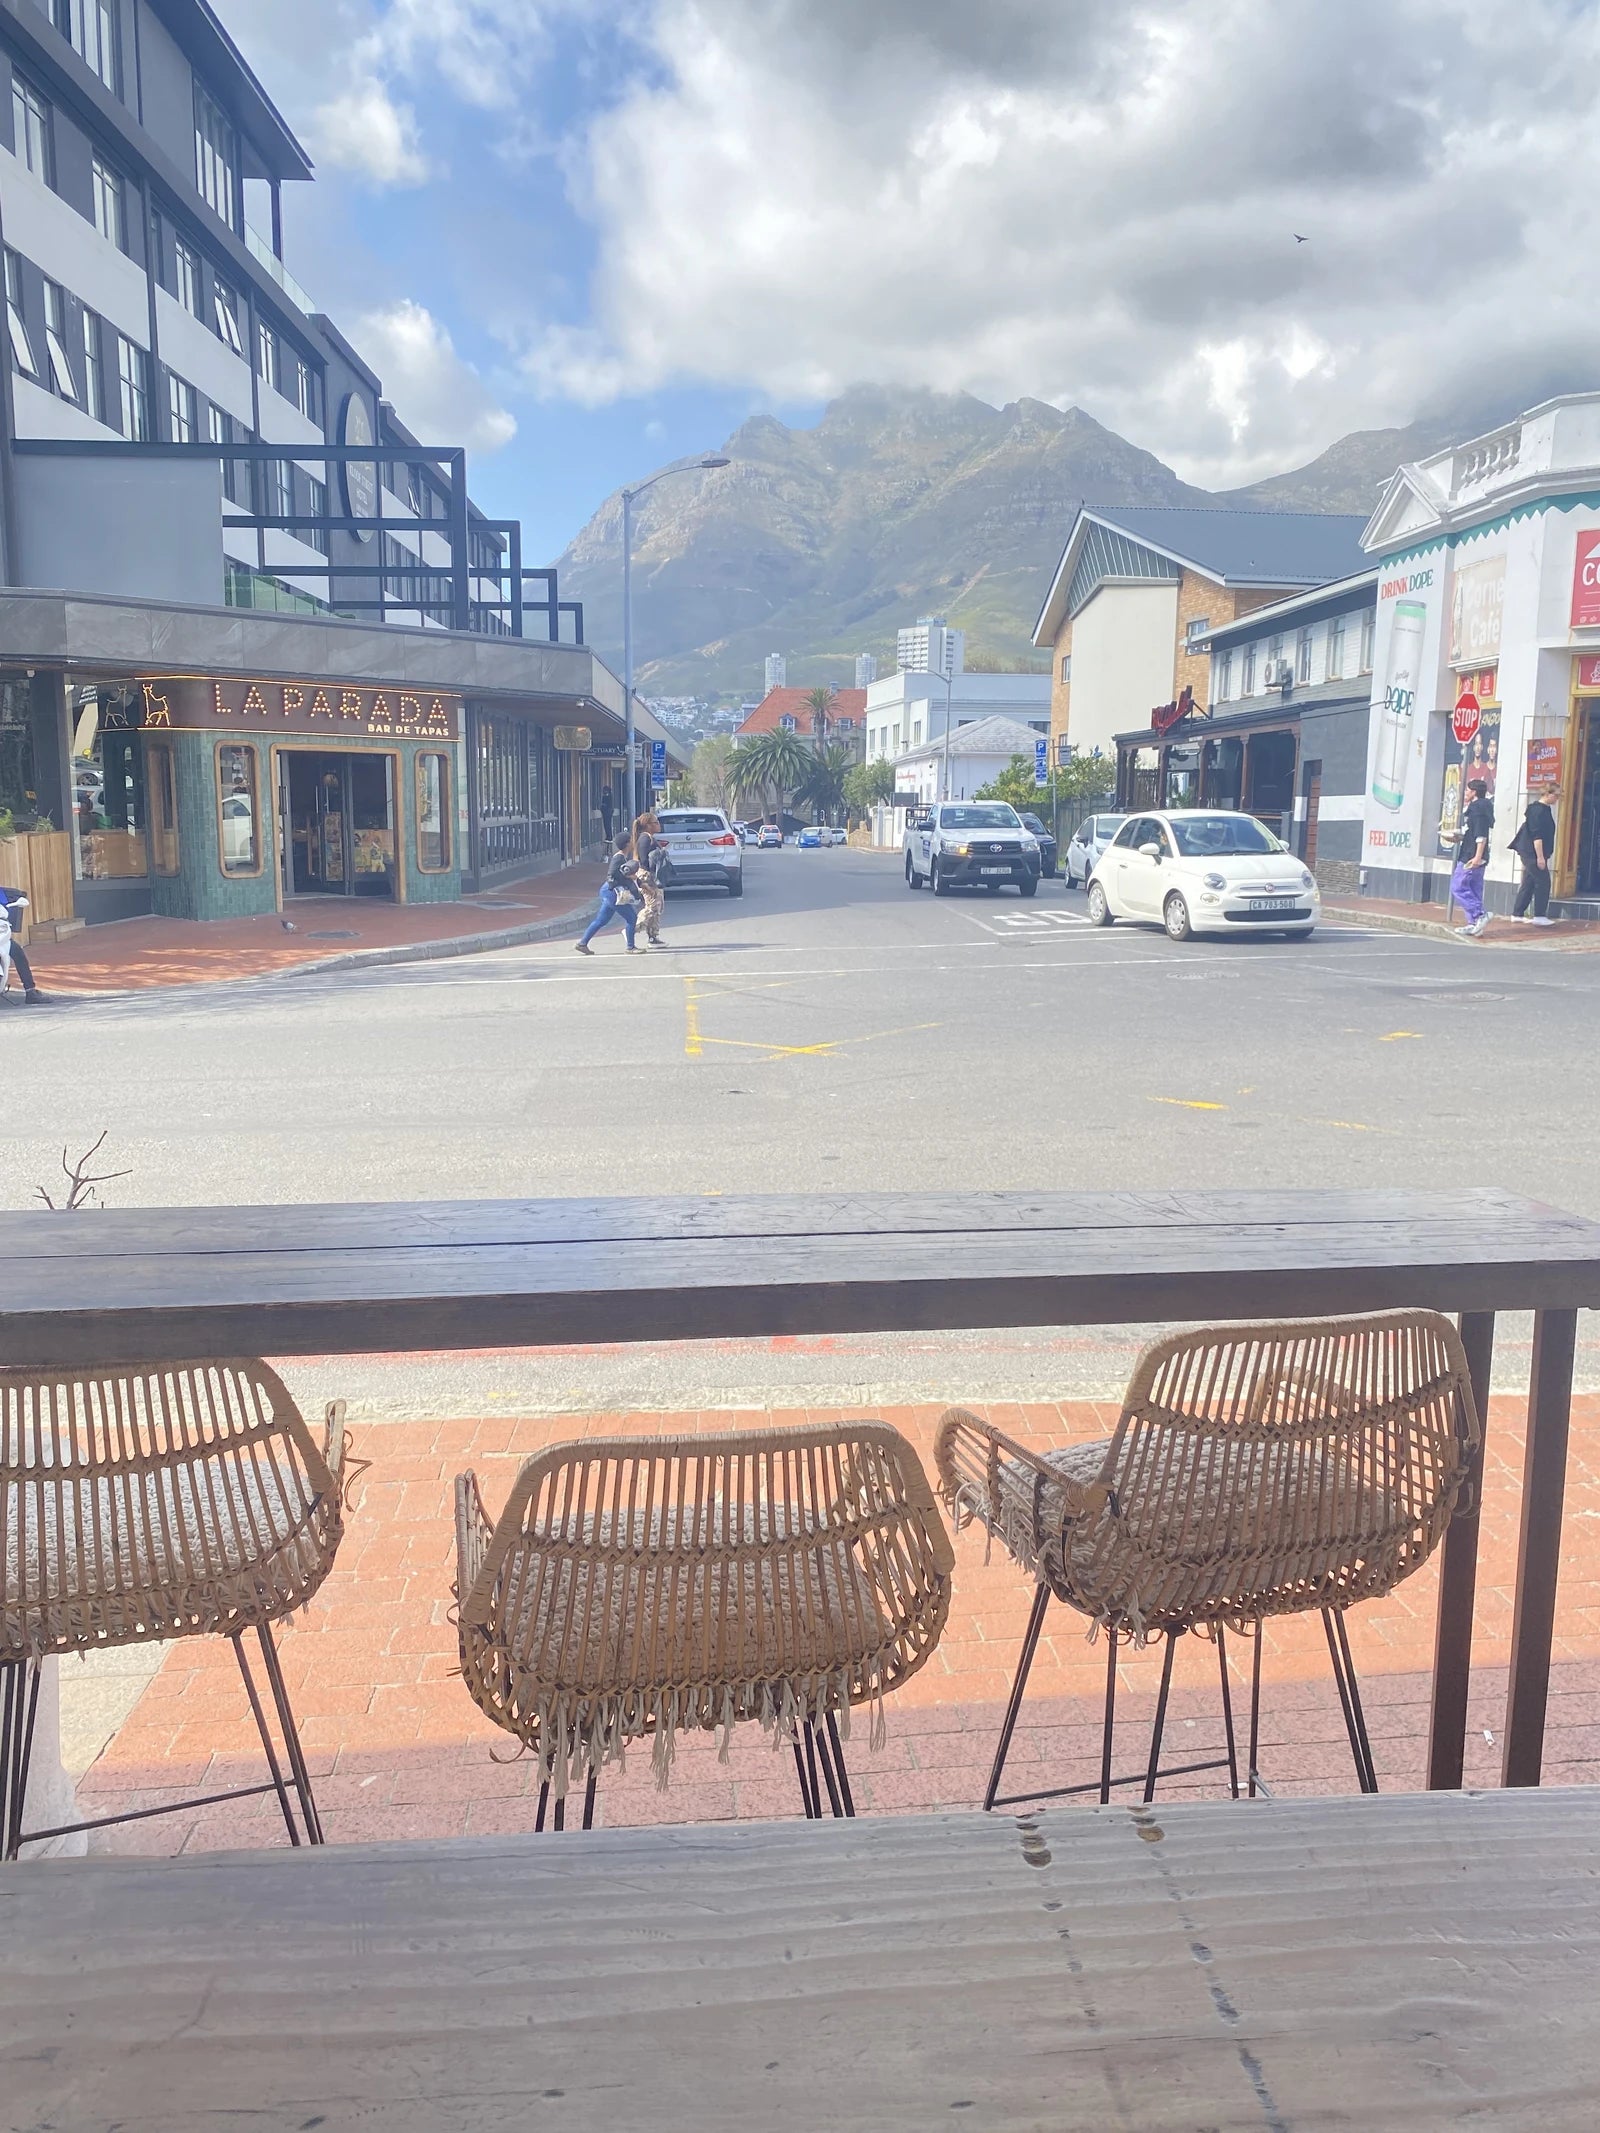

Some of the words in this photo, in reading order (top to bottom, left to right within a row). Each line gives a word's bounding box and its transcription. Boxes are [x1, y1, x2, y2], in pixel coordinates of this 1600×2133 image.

[1381, 577, 1408, 600] DRINK
[1409, 569, 1433, 592] DOPE
[1469, 608, 1501, 648] Café
[216, 684, 267, 715] LA
[283, 688, 449, 725] PARADA
[1384, 684, 1415, 717] DOPE
[1455, 707, 1478, 729] STOP
[367, 723, 391, 734] BAR
[395, 725, 411, 734] DE
[414, 726, 449, 737] TAPAS
[655, 743, 662, 752] P
[1037, 742, 1044, 751] P
[1370, 830, 1388, 847] FEEL
[1389, 831, 1411, 848] DOPE
[1252, 901, 1262, 910] CA
